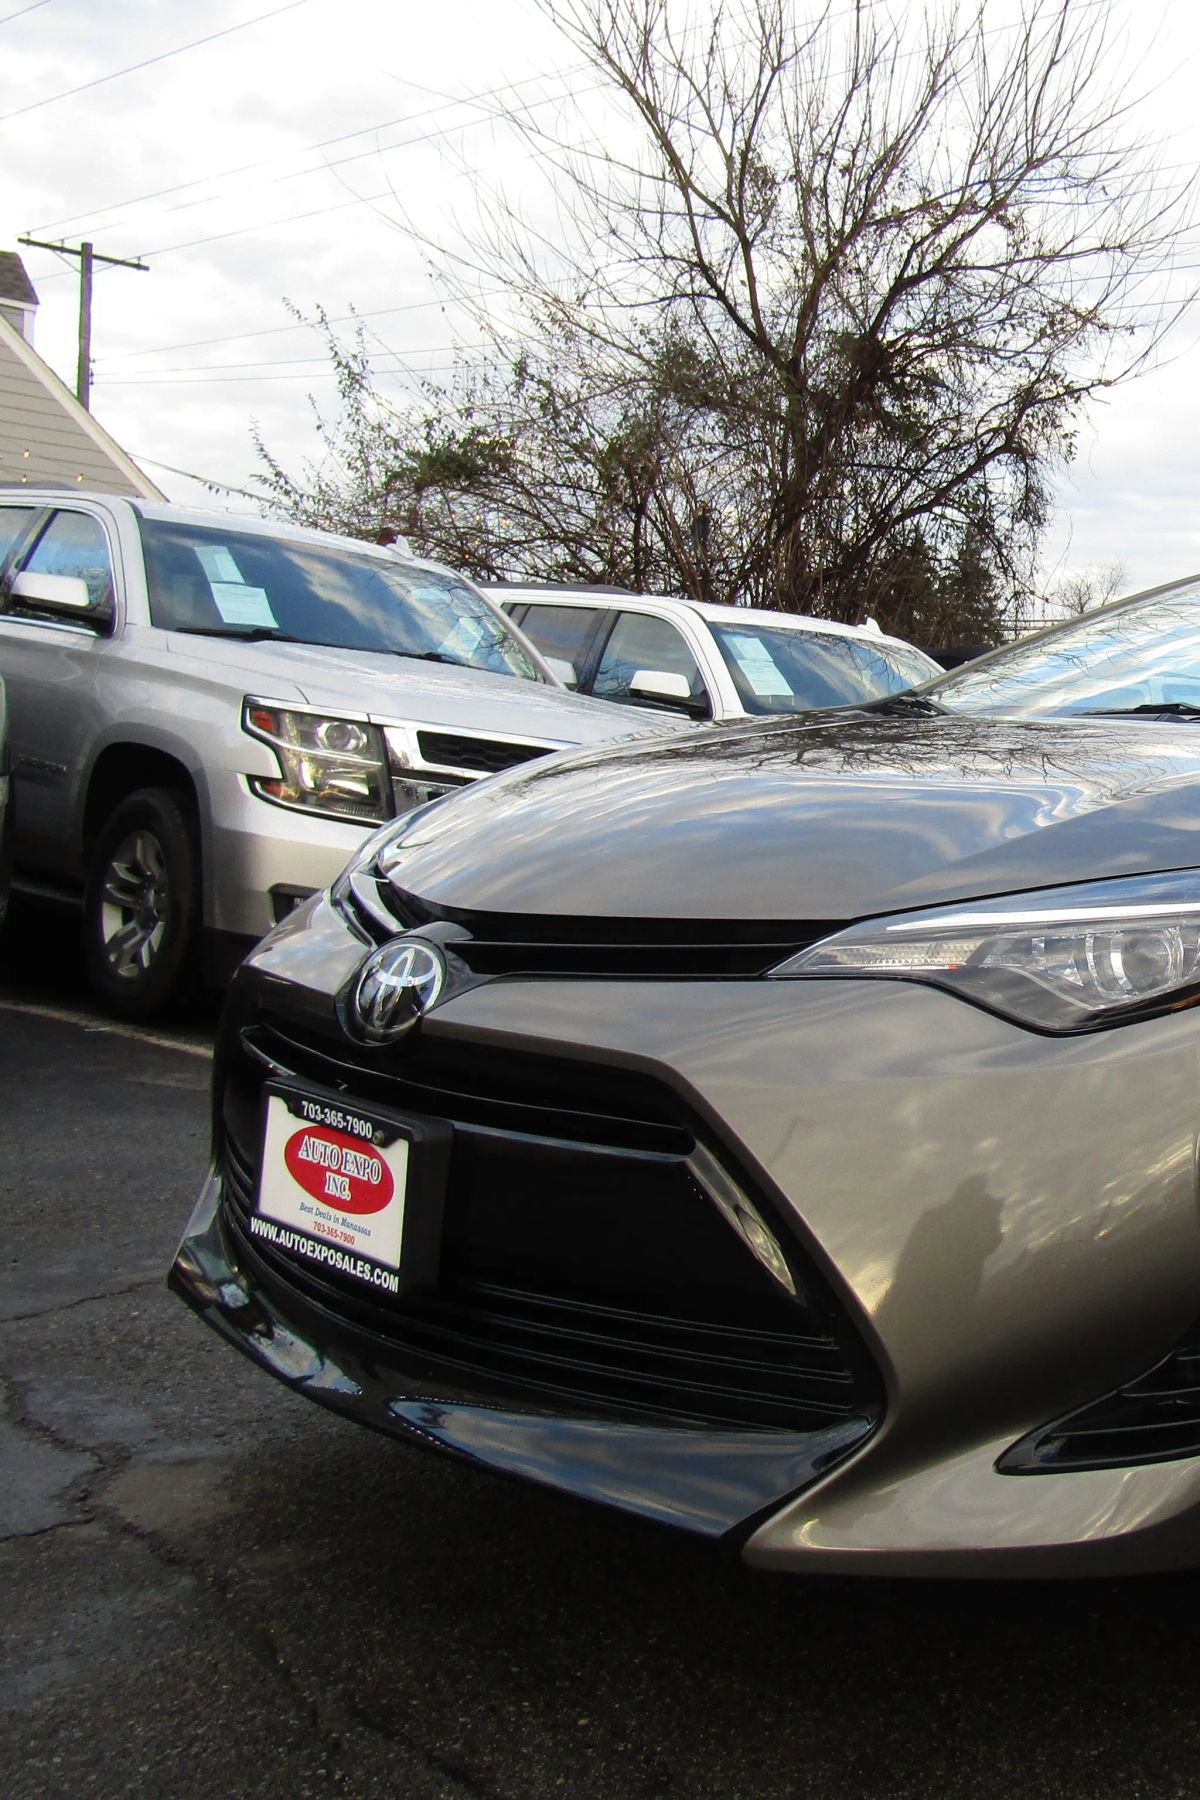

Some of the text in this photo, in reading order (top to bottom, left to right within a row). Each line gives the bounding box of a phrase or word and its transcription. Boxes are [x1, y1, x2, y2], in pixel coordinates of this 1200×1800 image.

[302, 1101, 373, 1139] 703-365-7900
[298, 1135, 383, 1185] AUTO EXPO
[325, 1171, 352, 1201] INC.
[300, 1202, 372, 1237] Best Deals in Manassas
[313, 1221, 356, 1246] 703-365-7900
[251, 1217, 400, 1293] WWW.AUTOEXPOSALES.COM
